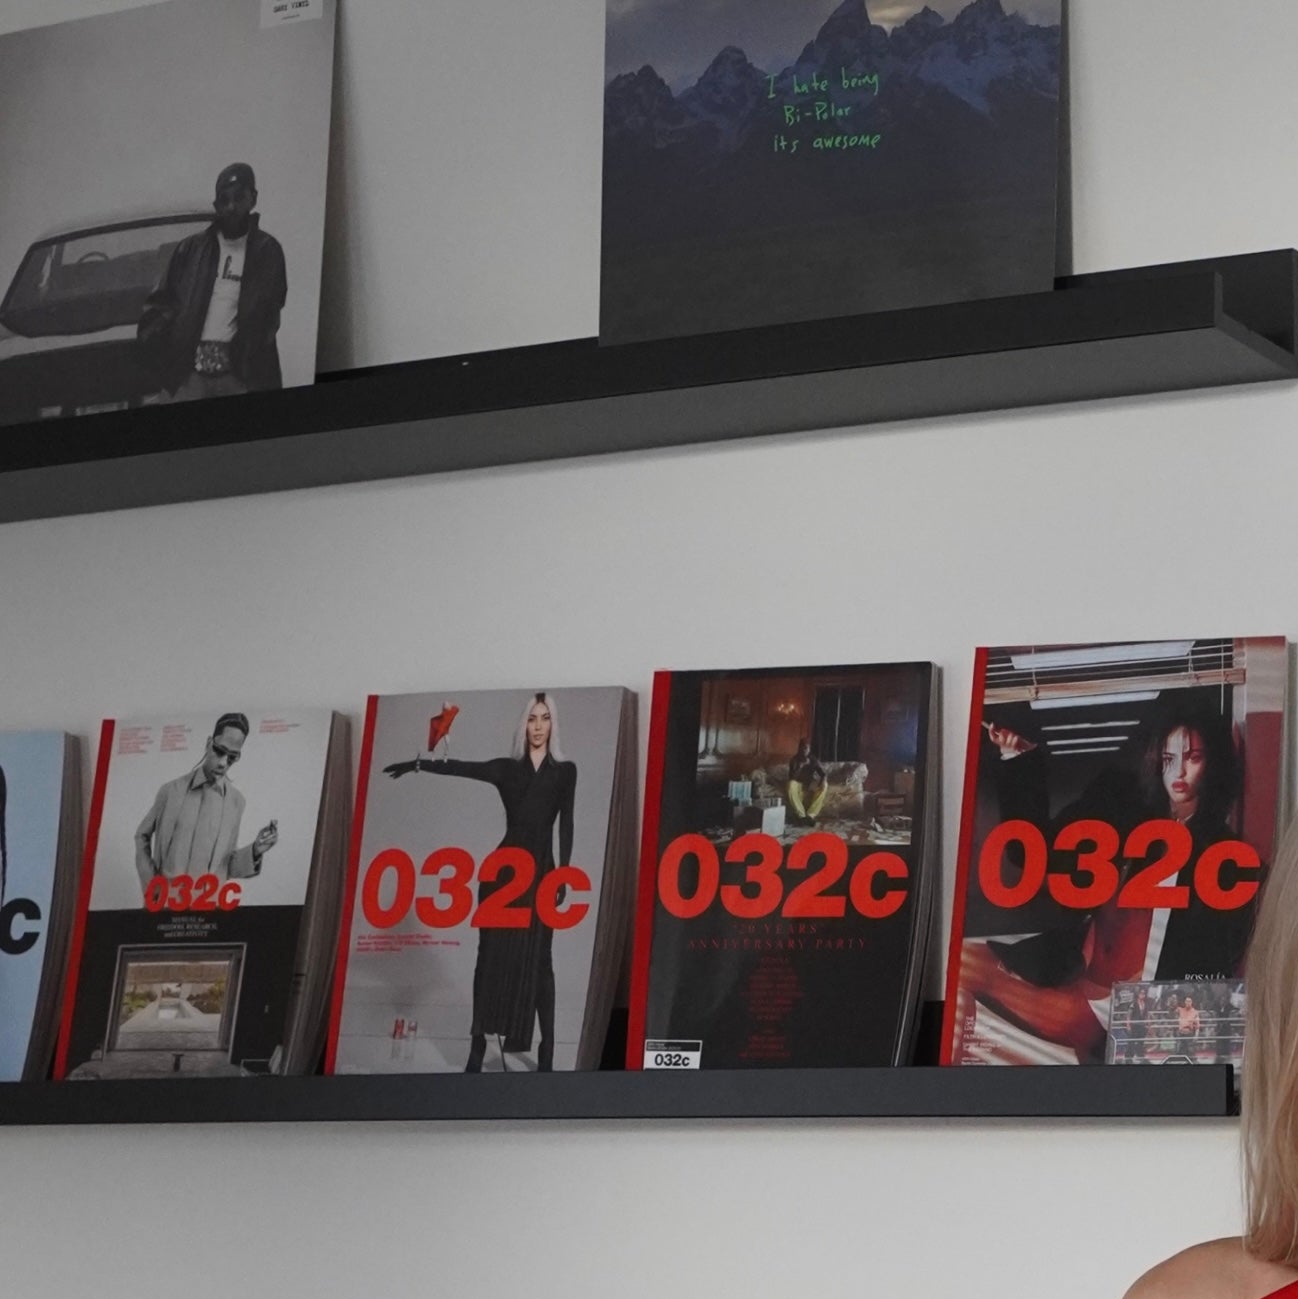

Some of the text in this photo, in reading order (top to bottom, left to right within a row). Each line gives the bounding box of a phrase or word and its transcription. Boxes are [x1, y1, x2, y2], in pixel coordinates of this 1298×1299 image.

[765, 66, 879, 99] I hate being
[783, 102, 851, 126] Bi-Polar
[774, 134, 881, 153] its awesome
[657, 831, 908, 919] 032c
[978, 819, 1261, 910] 032c
[144, 873, 242, 912] 032c
[361, 846, 592, 930] 032c
[654, 1053, 690, 1067] 032c
